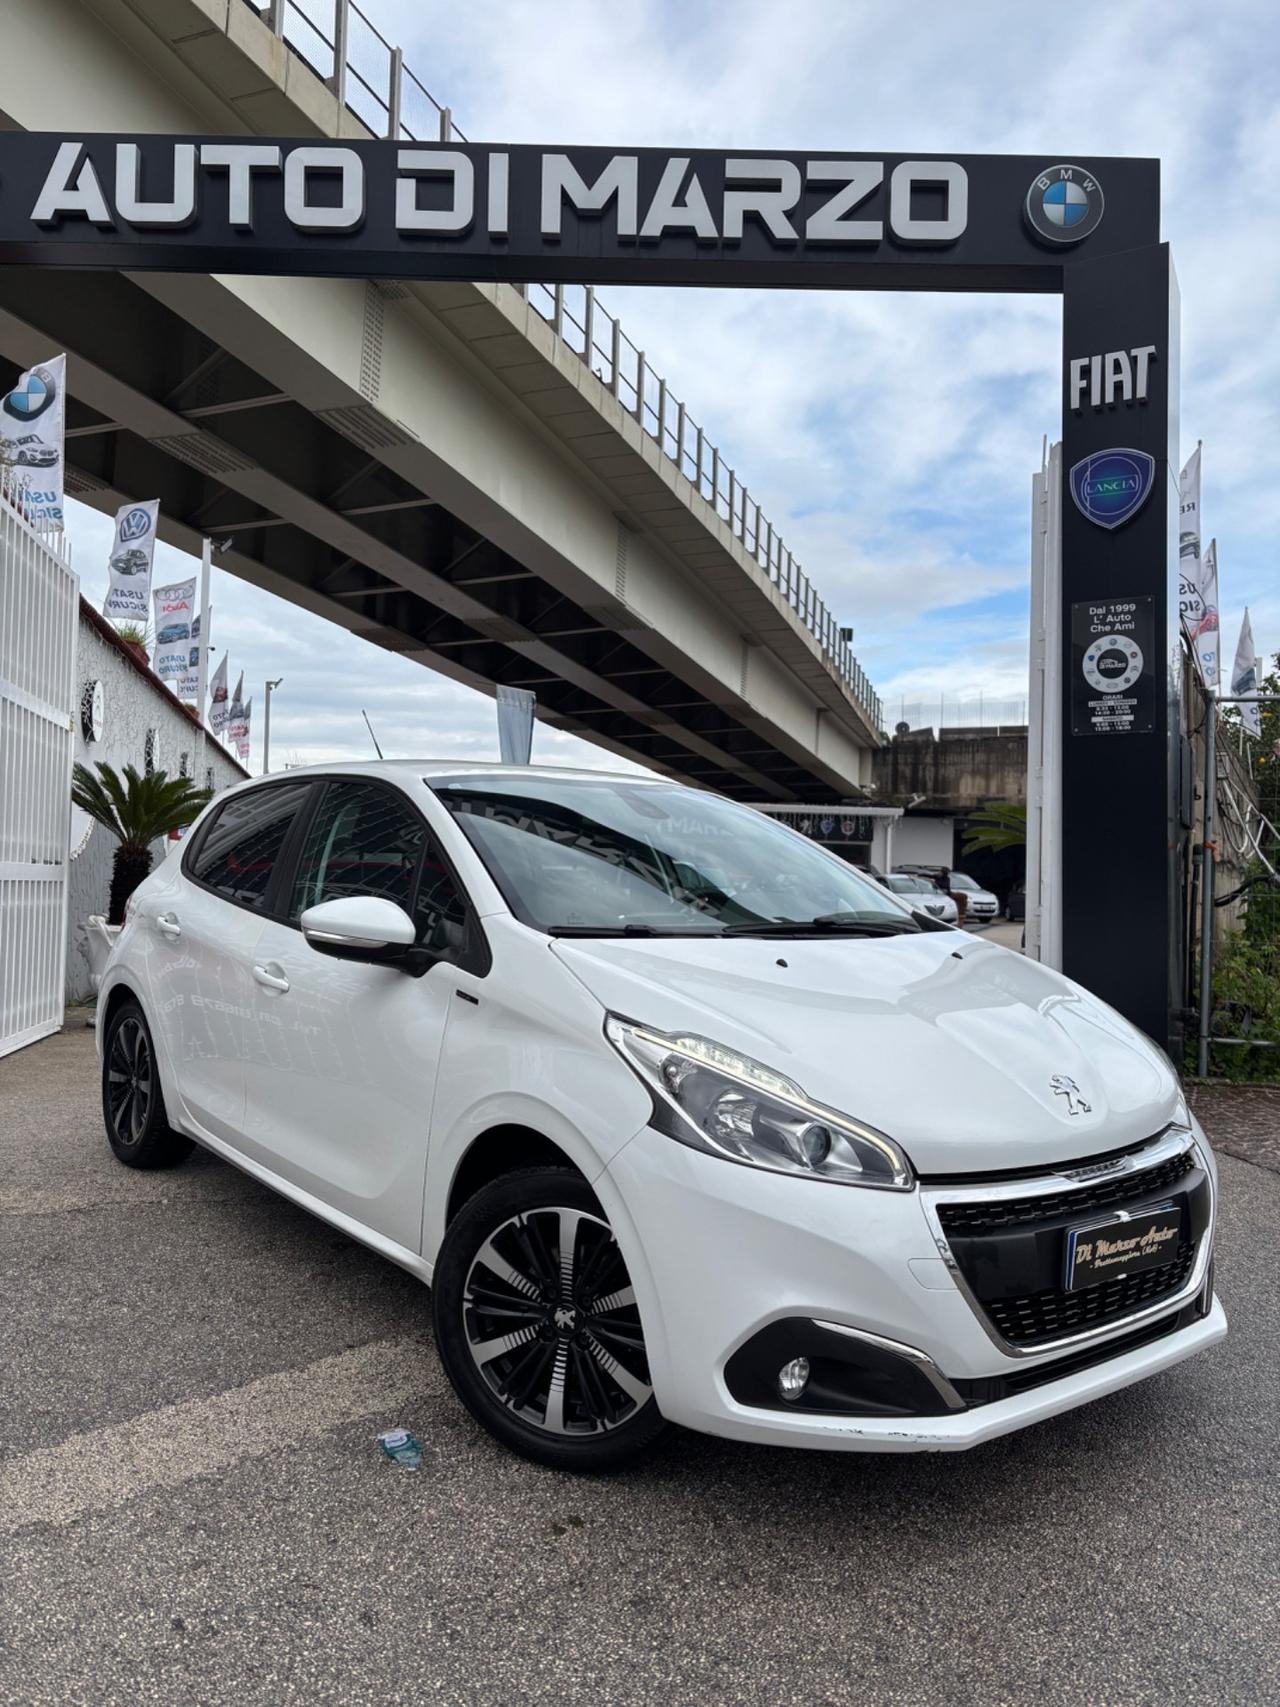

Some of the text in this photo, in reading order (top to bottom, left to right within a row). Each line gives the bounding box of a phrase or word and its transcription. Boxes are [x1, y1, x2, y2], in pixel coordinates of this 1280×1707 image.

[30, 142, 969, 246] AUTO DI MARZO
[1070, 345, 1156, 411] FIAT
[1087, 478, 1137, 496] LANCIA
[1089, 603, 1136, 615] Dal 1999
[1106, 613, 1132, 623] Auto
[1090, 621, 1135, 633] Che Ami
[1076, 1244, 1093, 1265] Di
